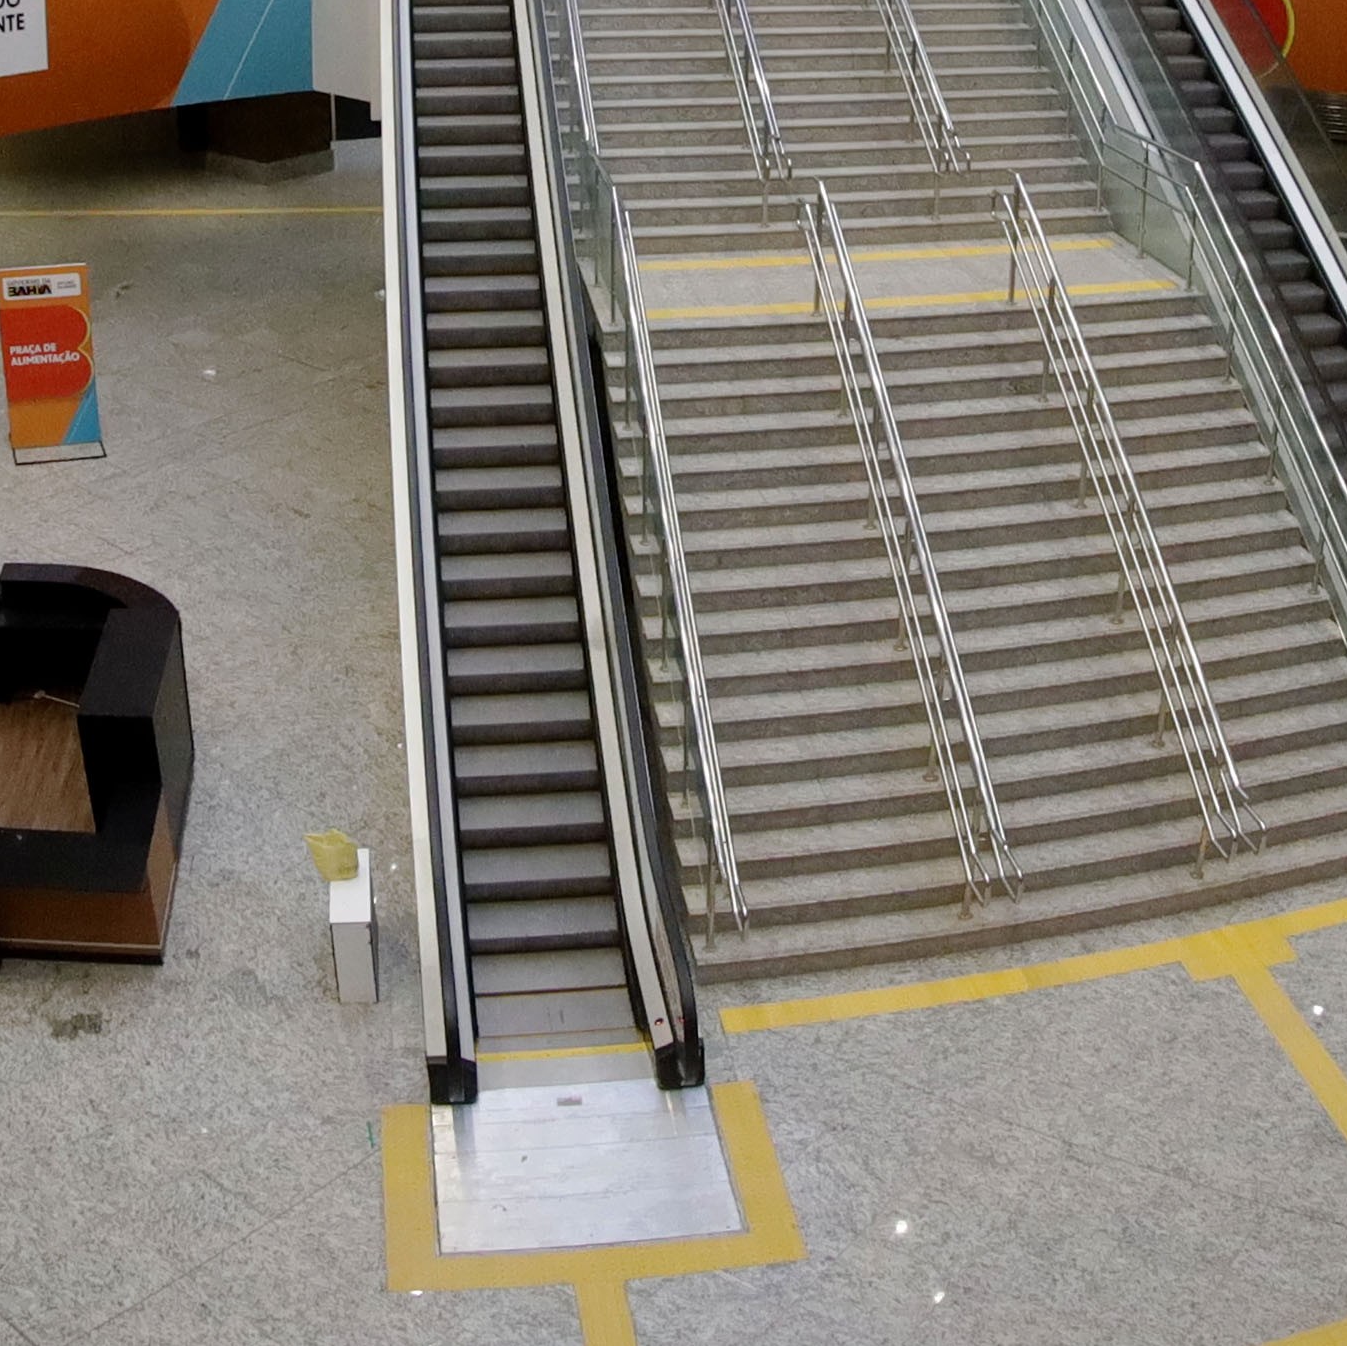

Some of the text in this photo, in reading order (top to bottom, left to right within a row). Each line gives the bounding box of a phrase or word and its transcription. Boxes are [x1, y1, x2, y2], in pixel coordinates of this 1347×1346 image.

[9, 342, 57, 356] PRAÇA DE
[10, 350, 81, 367] ALIMENTAÇÃO
